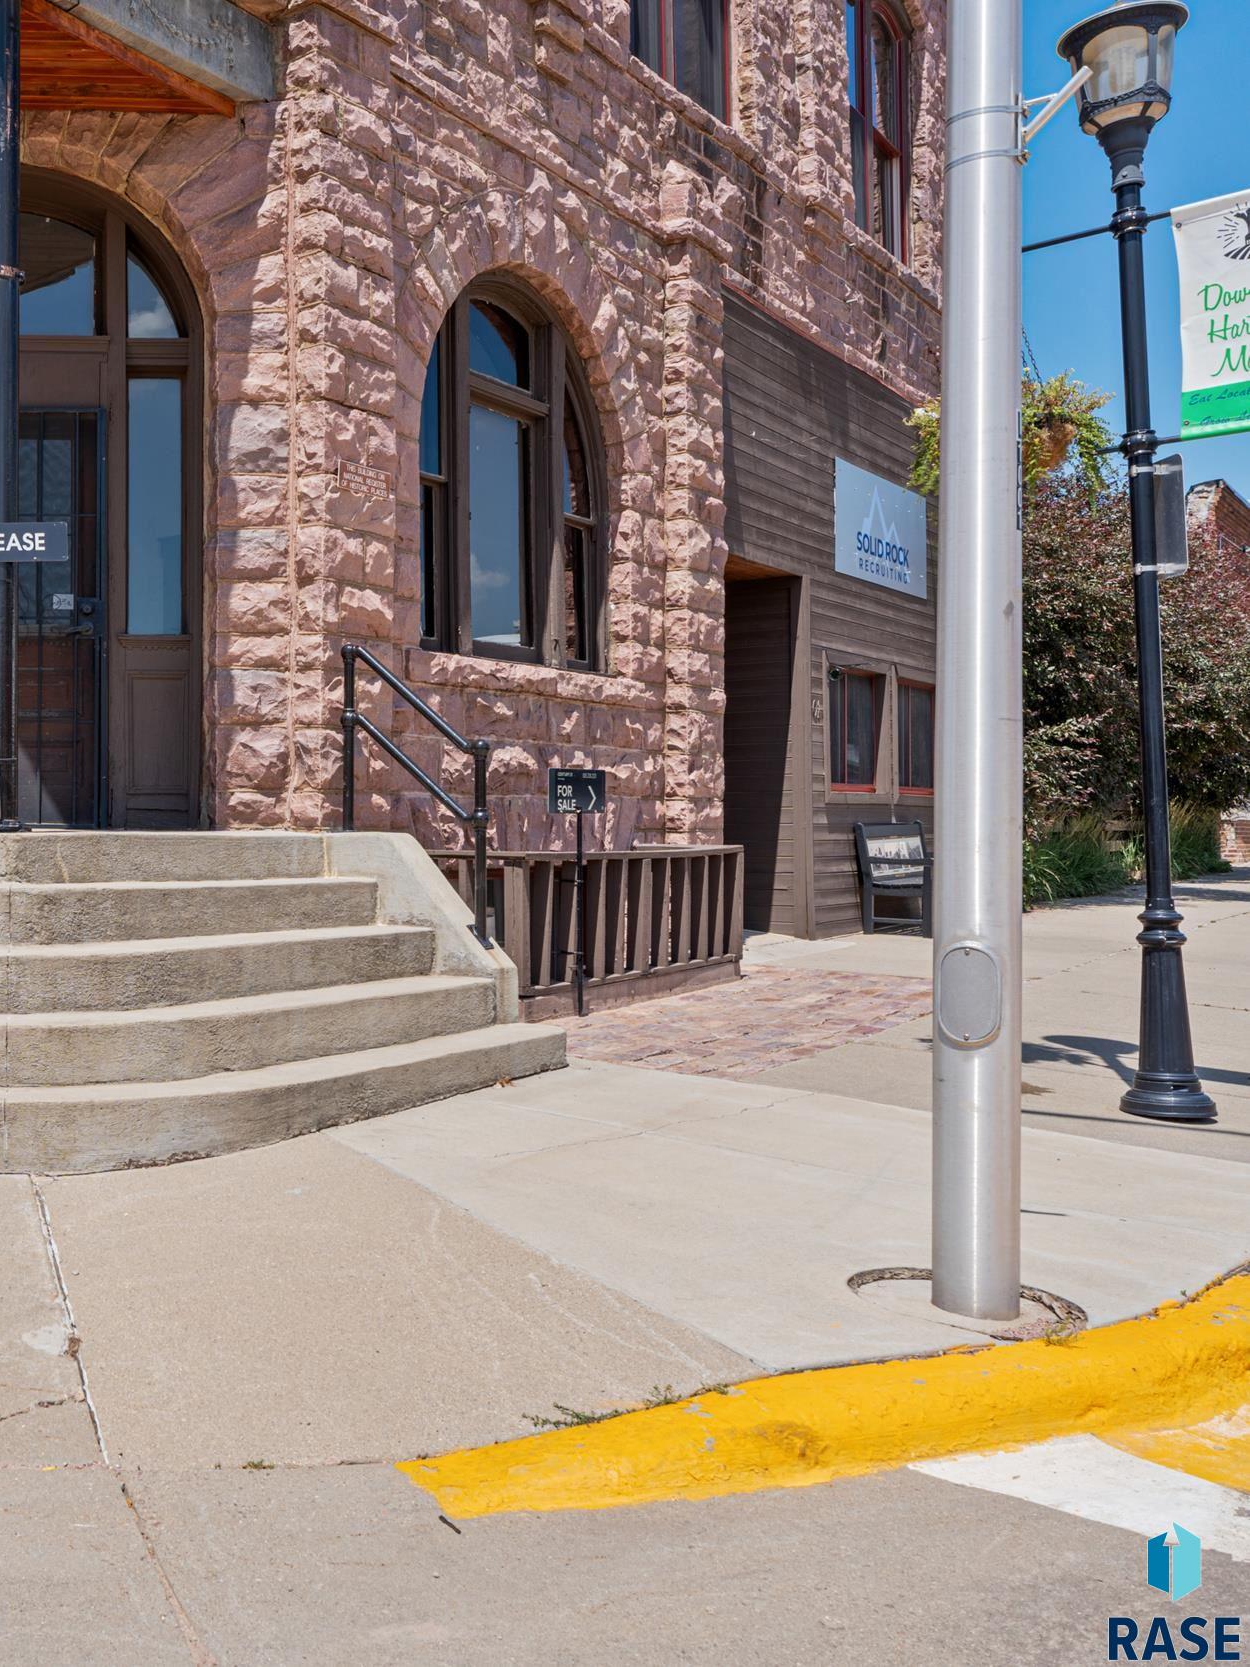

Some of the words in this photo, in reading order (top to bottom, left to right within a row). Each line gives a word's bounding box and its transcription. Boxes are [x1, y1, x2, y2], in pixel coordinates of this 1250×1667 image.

[1207, 314, 1250, 343] Har
[1210, 345, 1250, 377] M
[1188, 394, 1212, 406] Eat
[343, 472, 364, 483] NATIONAL
[365, 478, 387, 489] REGISTER
[357, 467, 377, 478] BUILDING
[350, 482, 370, 493] HISTORIC
[370, 487, 388, 497] PLACES
[857, 531, 884, 558] SOLID
[885, 542, 910, 568] ROCK
[859, 557, 908, 584] RECRUITING
[557, 785, 573, 797] FOR
[557, 799, 577, 811] SALE
